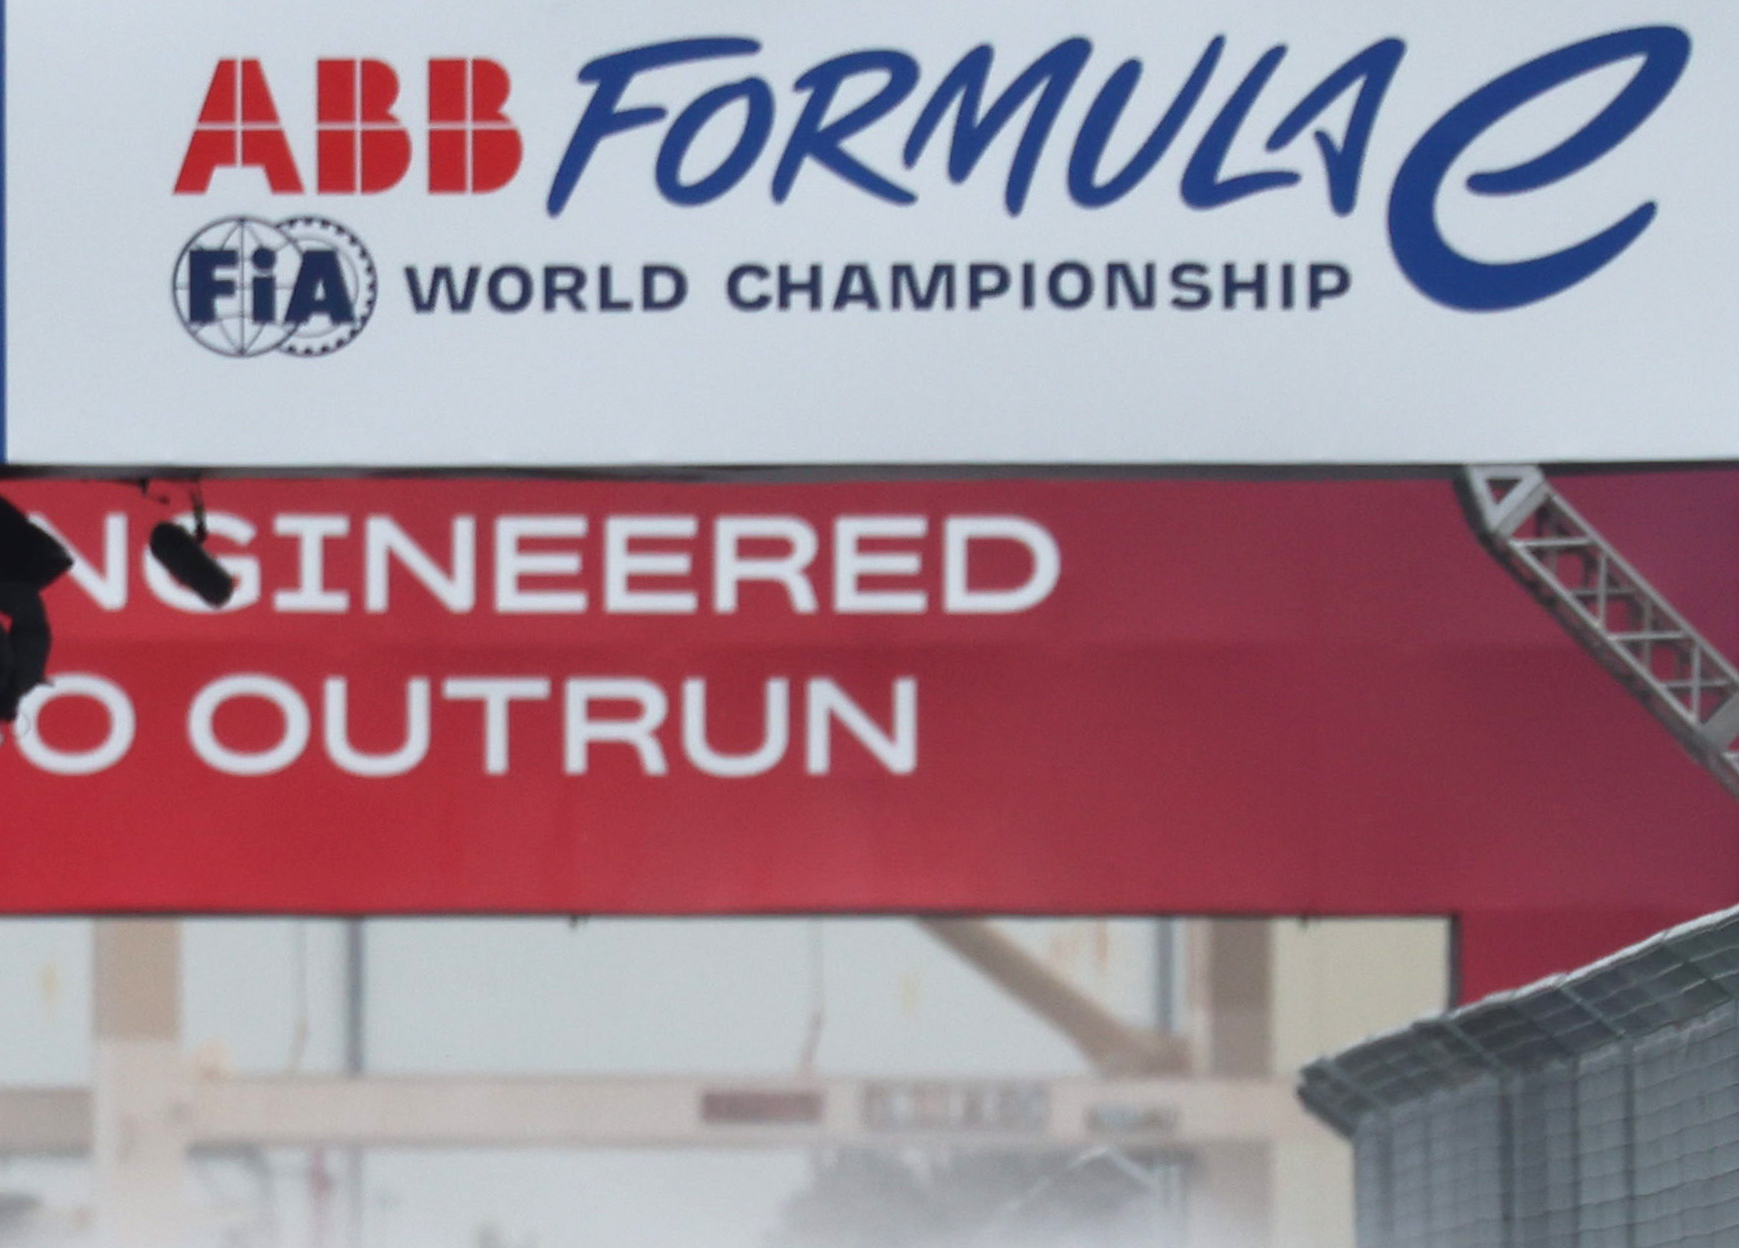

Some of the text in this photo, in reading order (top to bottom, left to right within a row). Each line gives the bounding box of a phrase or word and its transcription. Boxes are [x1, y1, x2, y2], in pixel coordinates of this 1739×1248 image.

[174, 59, 522, 194] ABB
[546, 35, 1407, 219] FORMULA
[404, 261, 1351, 313] WORLD CHAMPIONSHIP
[188, 674, 918, 777] OUTRUN
